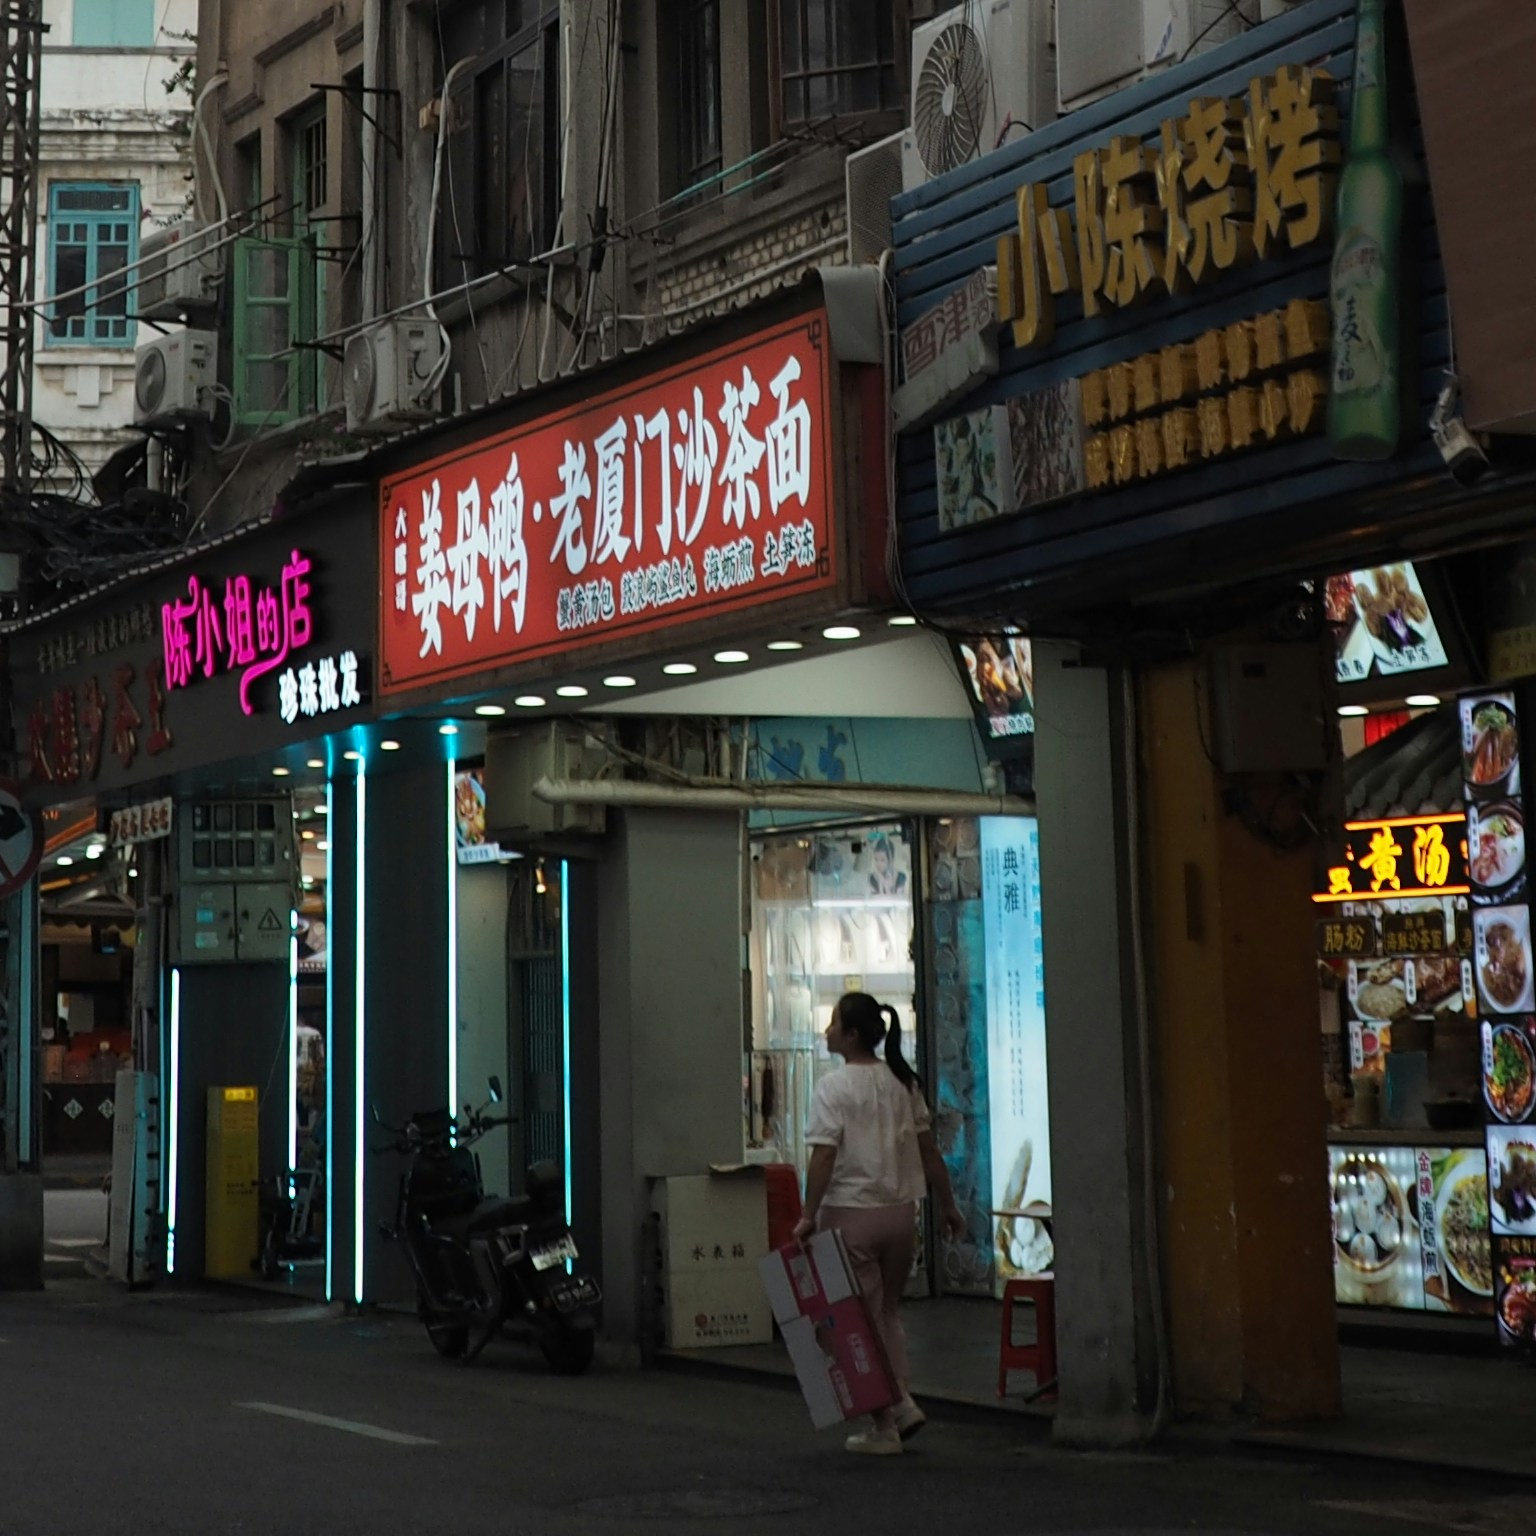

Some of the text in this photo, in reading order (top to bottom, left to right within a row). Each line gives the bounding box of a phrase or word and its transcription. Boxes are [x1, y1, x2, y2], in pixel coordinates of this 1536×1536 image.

[997, 65, 1338, 349] 小陈烧烤
[557, 577, 616, 631] 蟹黄汤包
[703, 536, 756, 593] 海蛎煎
[761, 518, 816, 577] 土笋冻
[161, 547, 315, 716] 陈小姐的店
[278, 650, 361, 725] 珍珠批发
[1003, 847, 1021, 914] 典雅
[1328, 824, 1469, 895] 黄汤
[1324, 923, 1365, 953] 肠粉
